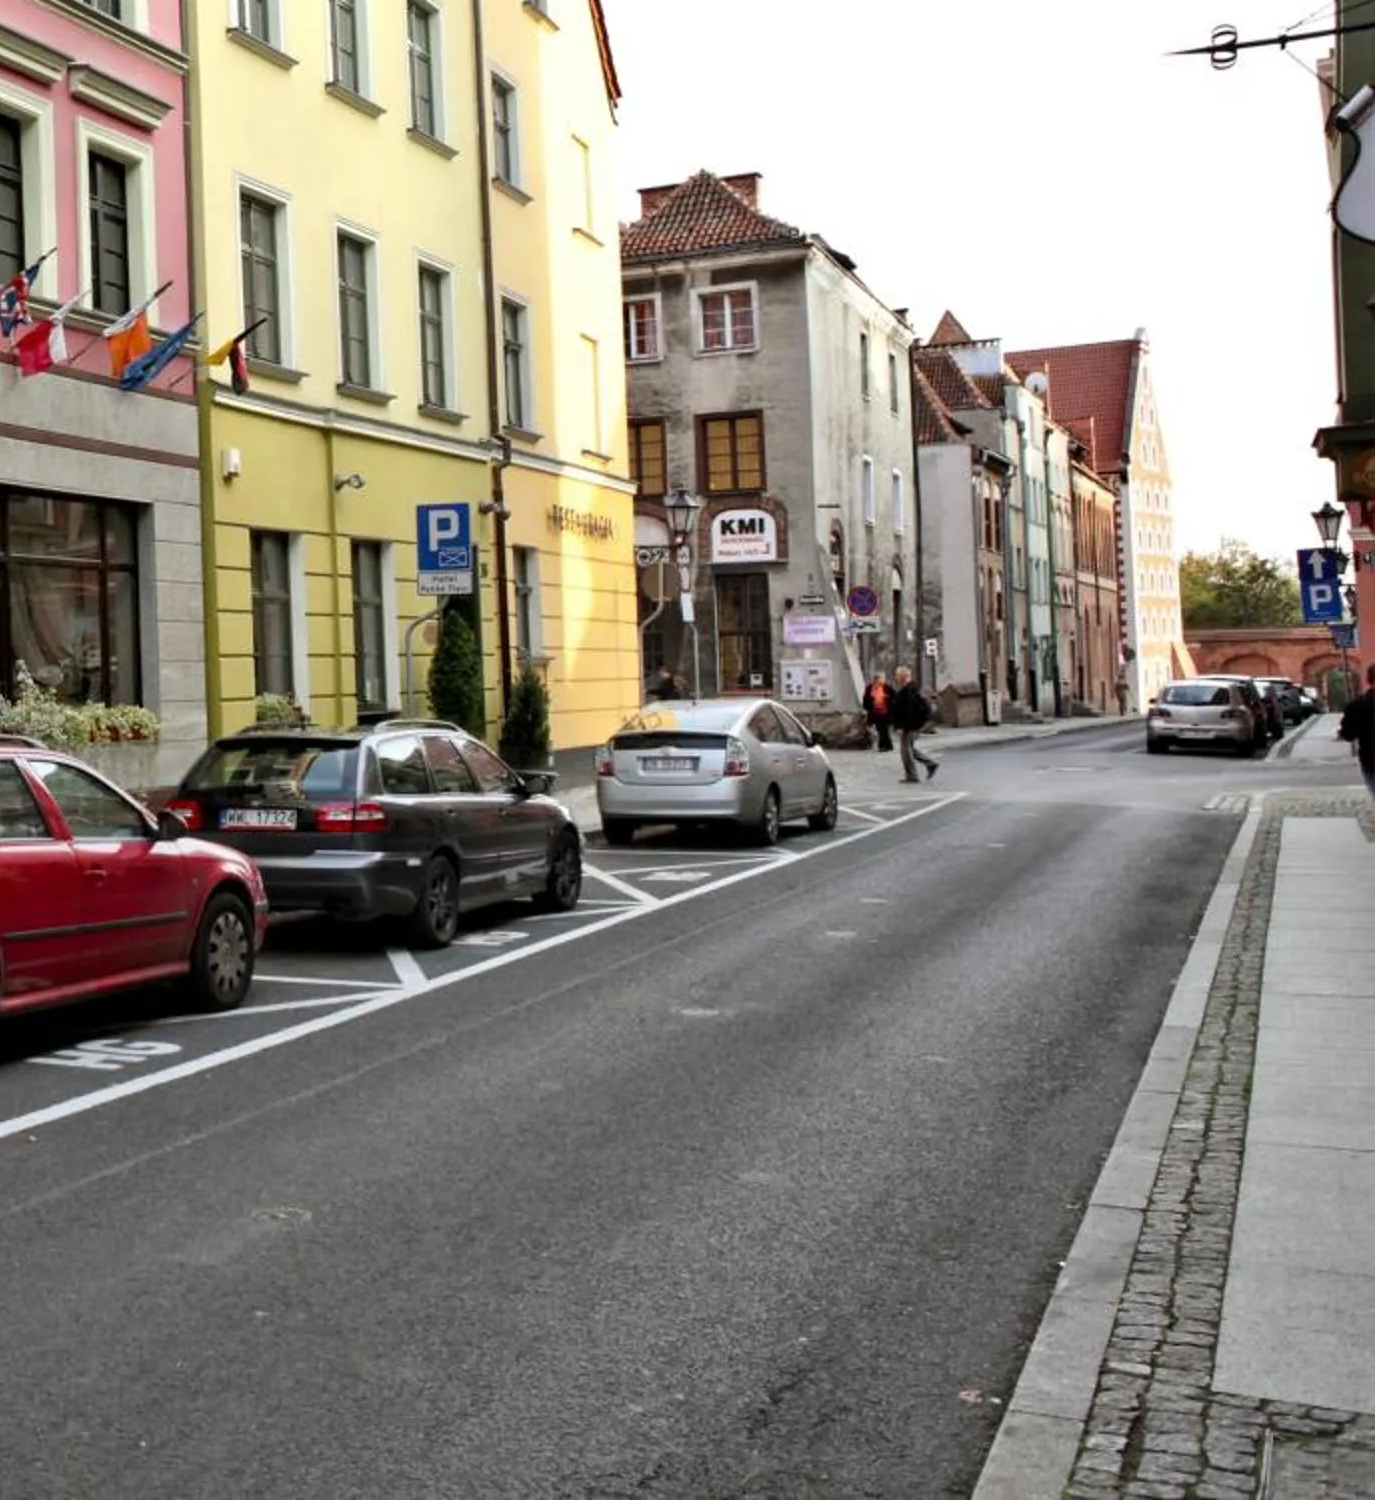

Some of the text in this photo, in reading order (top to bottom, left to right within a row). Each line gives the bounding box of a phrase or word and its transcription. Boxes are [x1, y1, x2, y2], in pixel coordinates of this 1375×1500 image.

[428, 509, 459, 552] P
[720, 518, 765, 535] KMI
[1309, 584, 1333, 611] P
